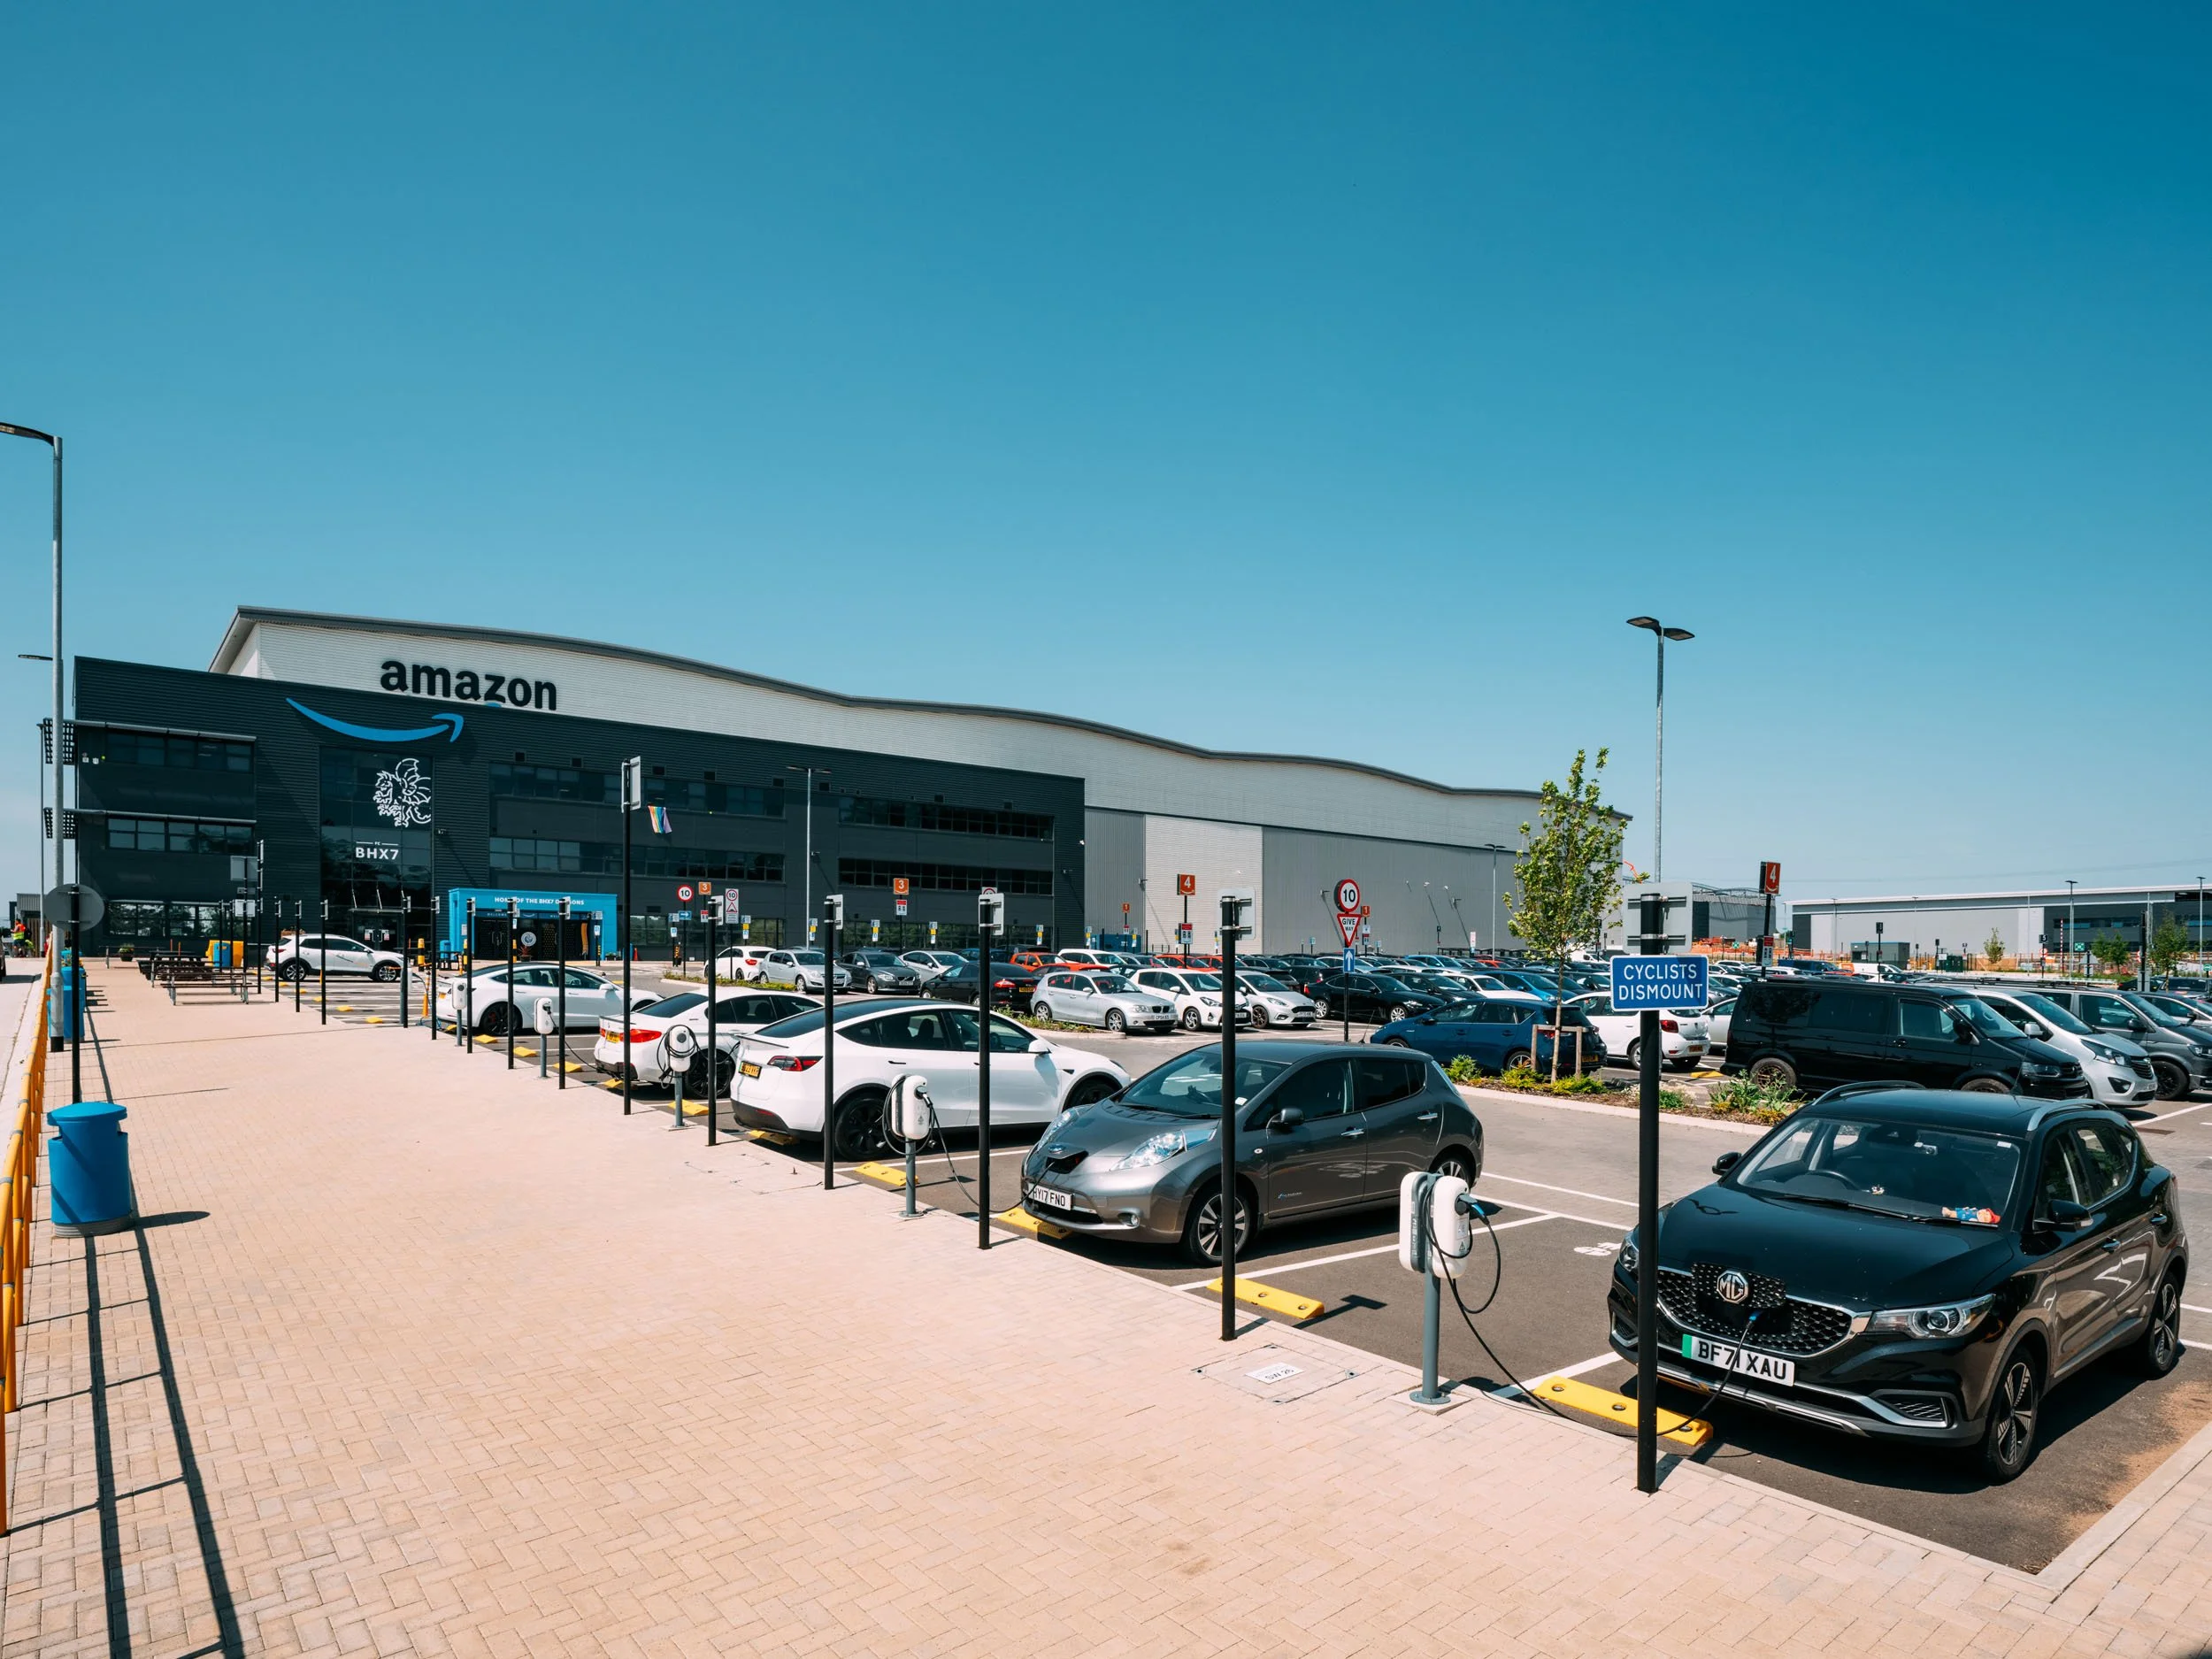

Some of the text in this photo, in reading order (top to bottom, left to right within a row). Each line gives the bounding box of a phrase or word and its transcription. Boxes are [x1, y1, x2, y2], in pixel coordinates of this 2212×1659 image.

[380, 660, 557, 711] amazon
[356, 847, 399, 860] BHX7
[1770, 864, 1777, 883] 4
[898, 879, 904, 889] 3
[1184, 876, 1191, 888] 4
[1343, 889, 1356, 902] 10
[1624, 964, 1697, 979] CYCLISTS
[1618, 984, 1703, 1001] DISMOUNT
[1719, 1274, 1744, 1300] MG
[1698, 1340, 1786, 1380] BF71 XAU
